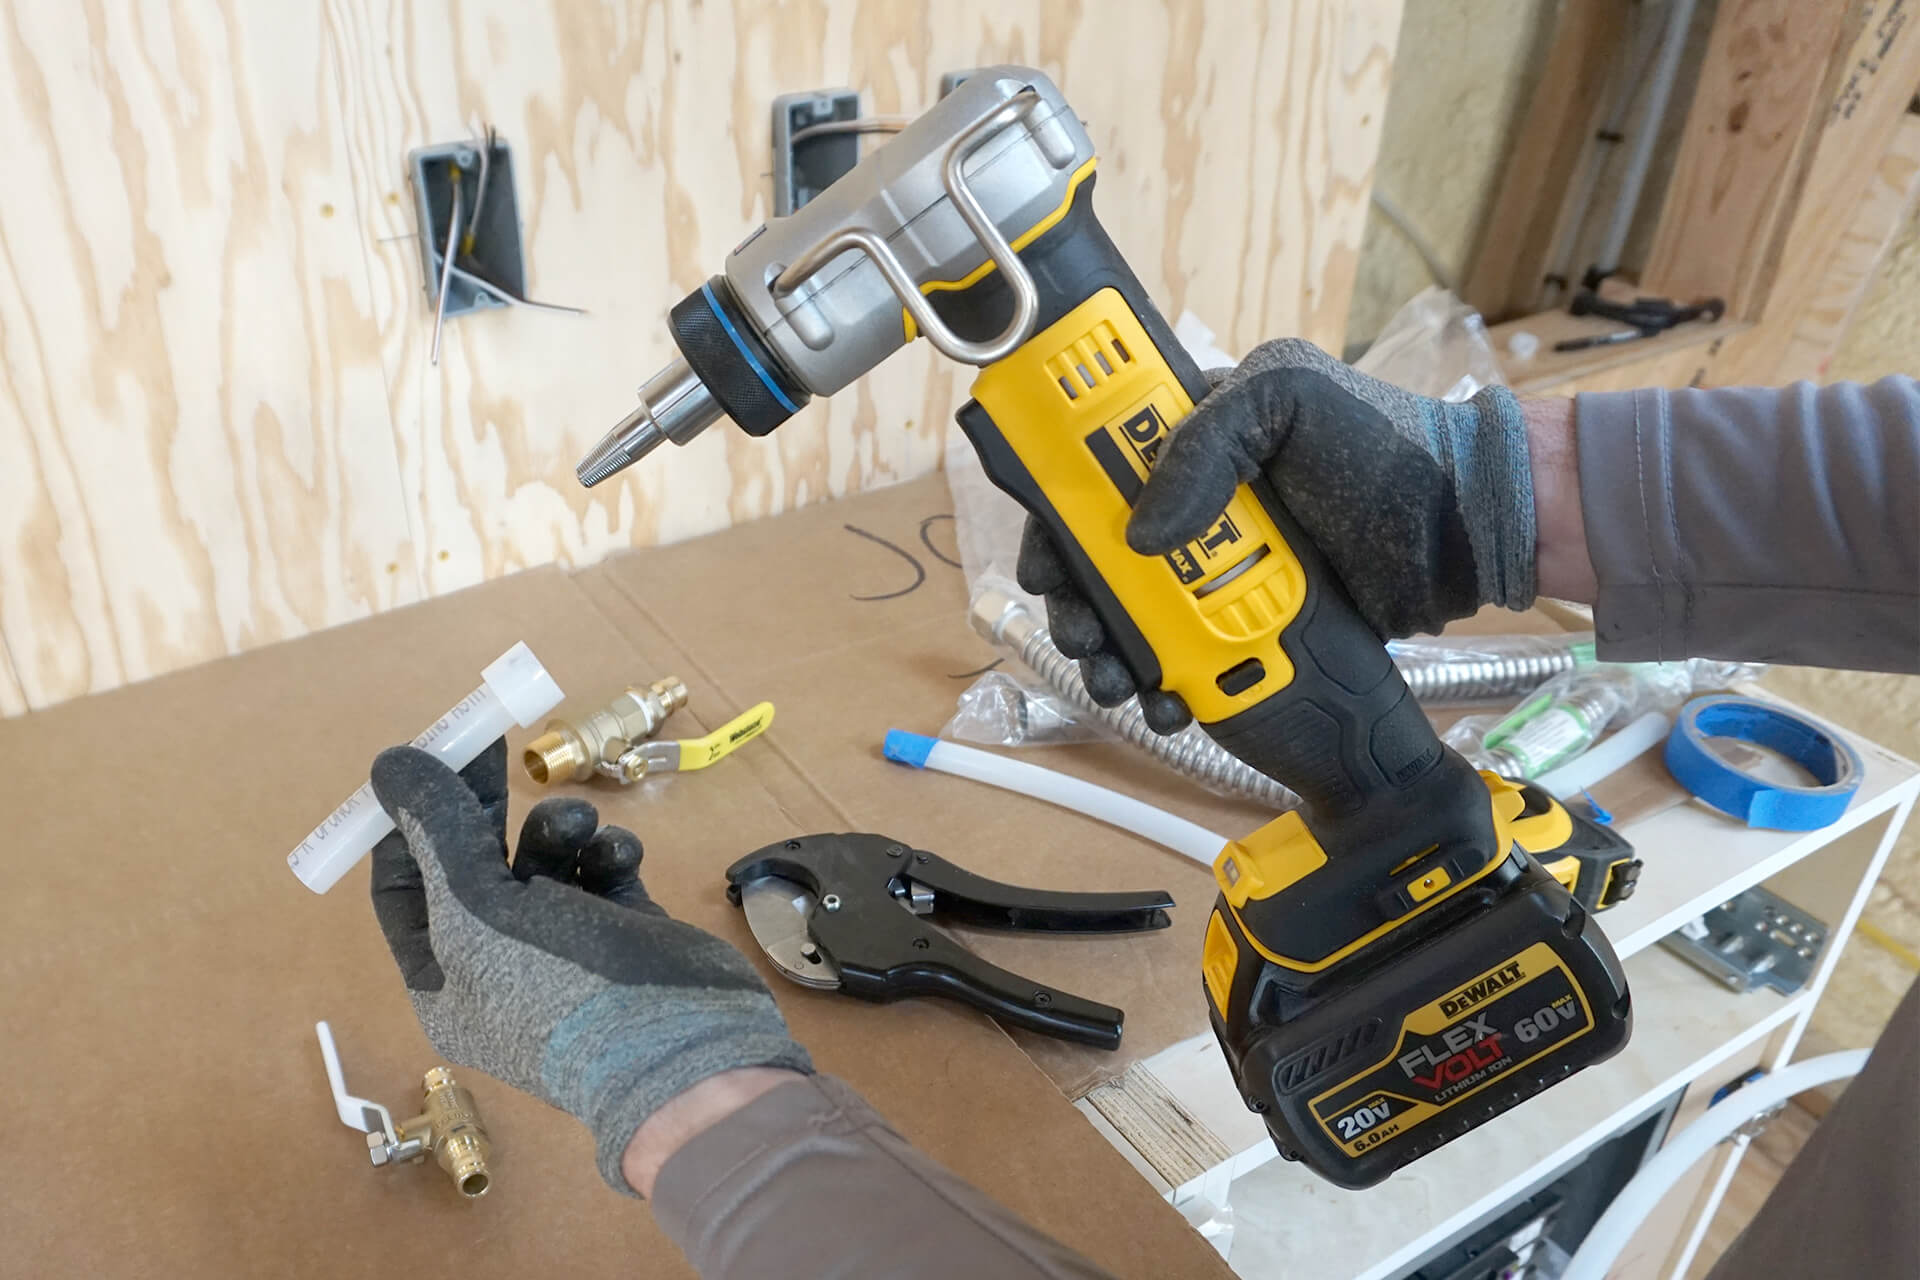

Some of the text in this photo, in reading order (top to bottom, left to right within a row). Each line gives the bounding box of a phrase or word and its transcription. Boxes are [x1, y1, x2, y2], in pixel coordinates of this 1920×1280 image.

[1397, 1011, 1498, 1079] FLEX
[1411, 1032, 1503, 1089] VOLT
[1434, 1056, 1513, 1102] LITHIUM ION
